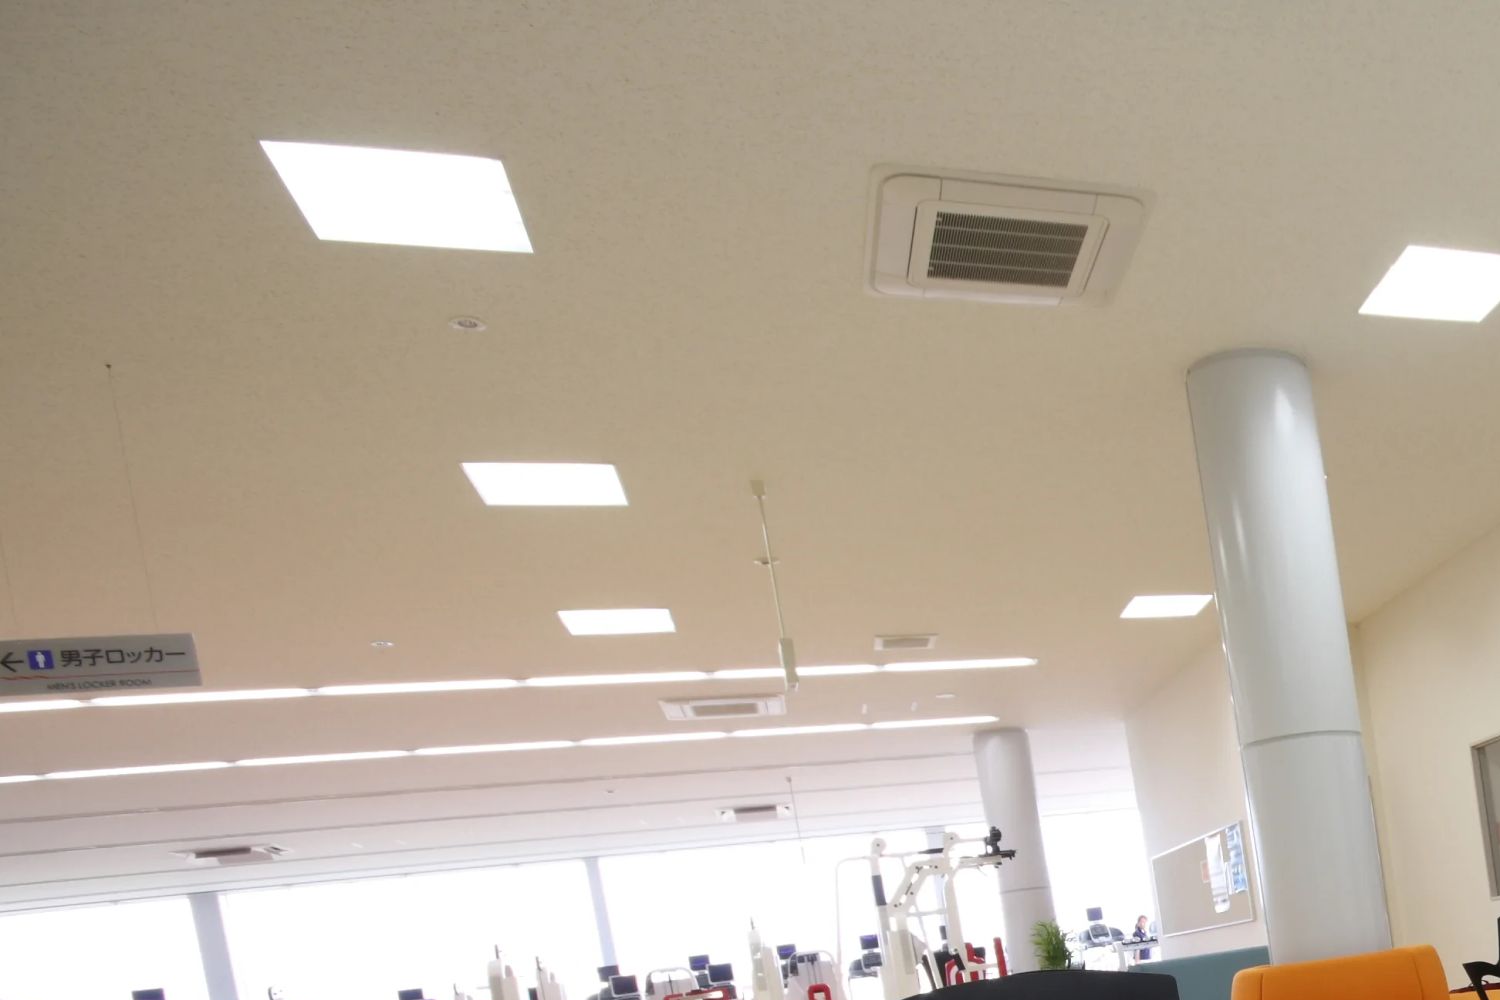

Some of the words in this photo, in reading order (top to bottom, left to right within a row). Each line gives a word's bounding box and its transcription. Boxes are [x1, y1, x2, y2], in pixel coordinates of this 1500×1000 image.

[61, 647, 186, 668] 男子ロッカー
[79, 680, 116, 689] LOCKER
[118, 679, 152, 688] ROOM
